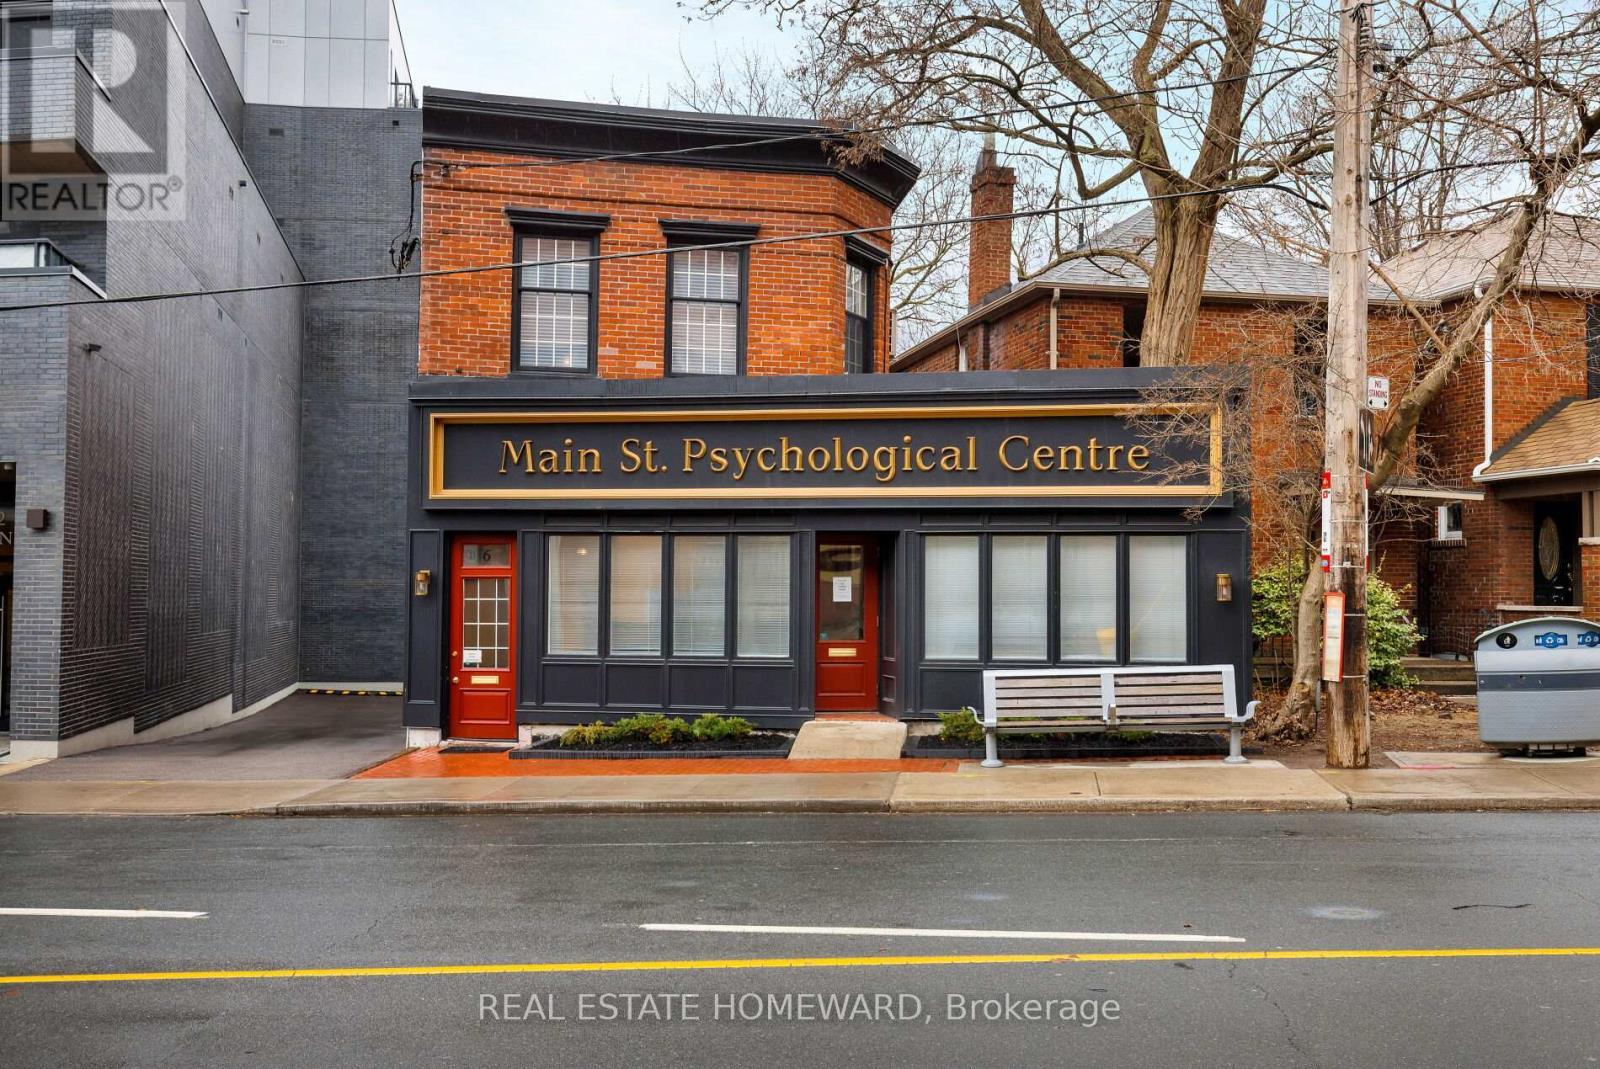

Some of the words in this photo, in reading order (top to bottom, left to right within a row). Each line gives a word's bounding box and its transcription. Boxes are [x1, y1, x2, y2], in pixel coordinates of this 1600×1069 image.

[498, 438, 602, 474] Main
[619, 438, 669, 473] St.
[681, 435, 979, 482] Psychological
[998, 435, 1151, 472] Centre
